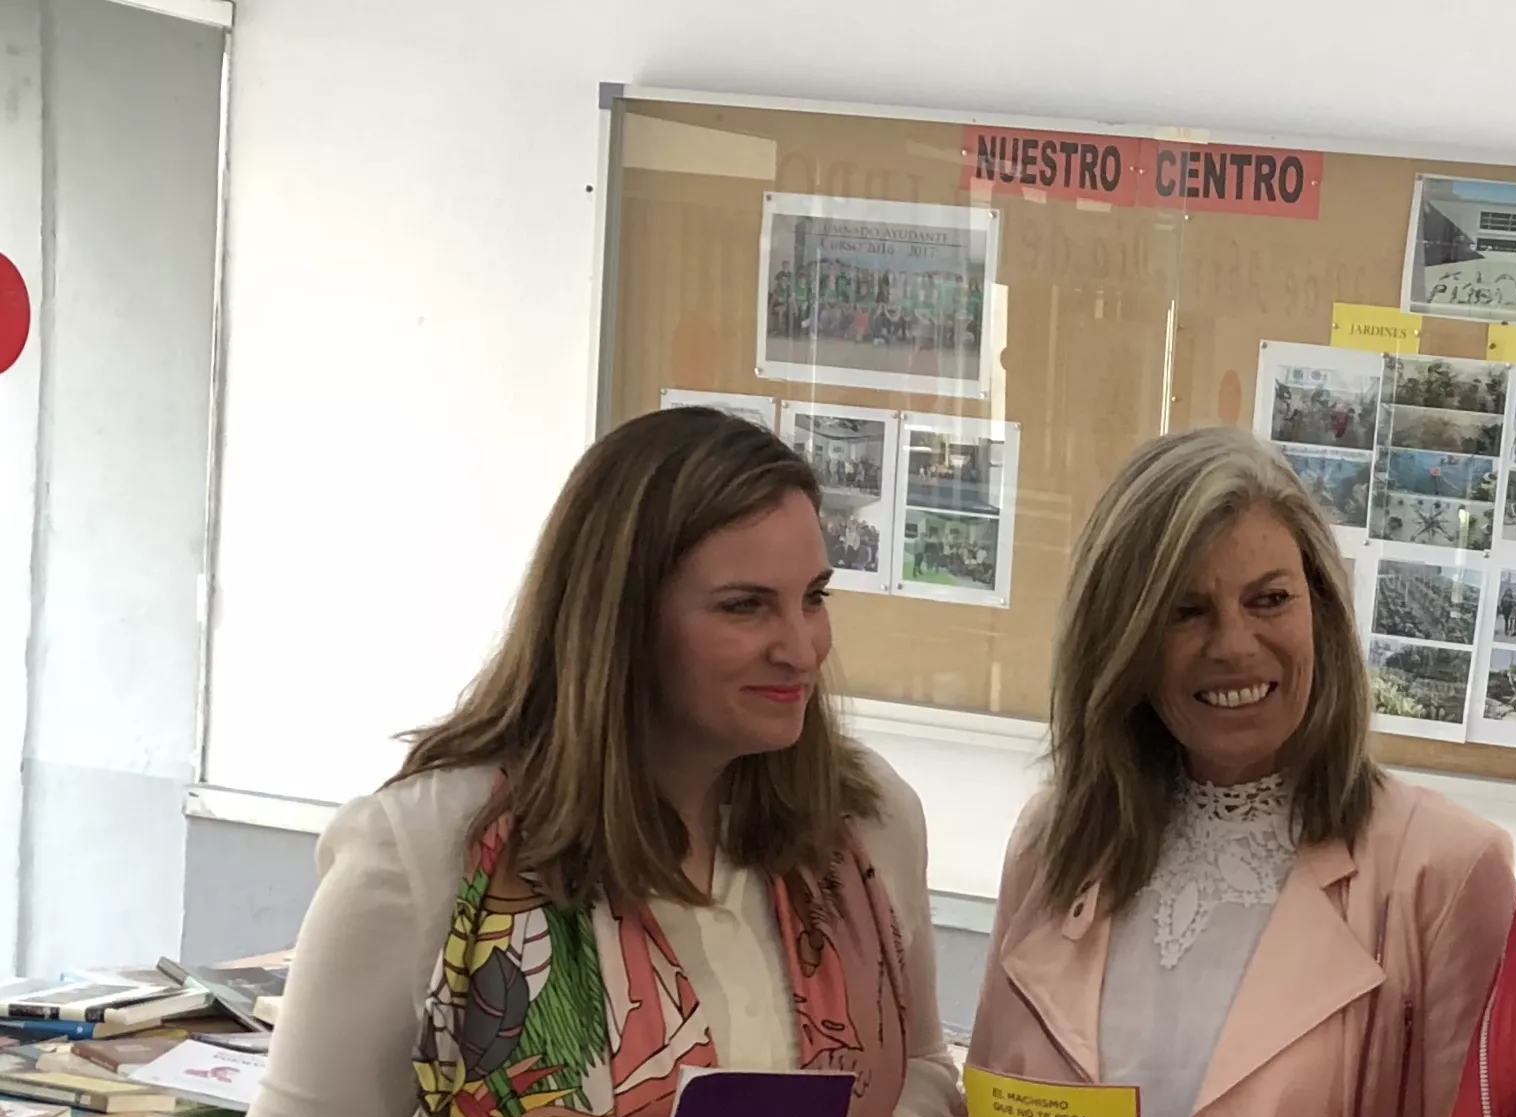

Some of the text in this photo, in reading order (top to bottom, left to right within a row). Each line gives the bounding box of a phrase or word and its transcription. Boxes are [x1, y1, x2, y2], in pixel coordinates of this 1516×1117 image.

[976, 135, 1121, 192] NUESTRO
[1155, 150, 1304, 204] CENTRO
[883, 227, 949, 242] AYUDANTE
[1349, 323, 1407, 338] JARDINES
[992, 1087, 1069, 1110] EL MACHISMO
[993, 1101, 1014, 1115] QUE
